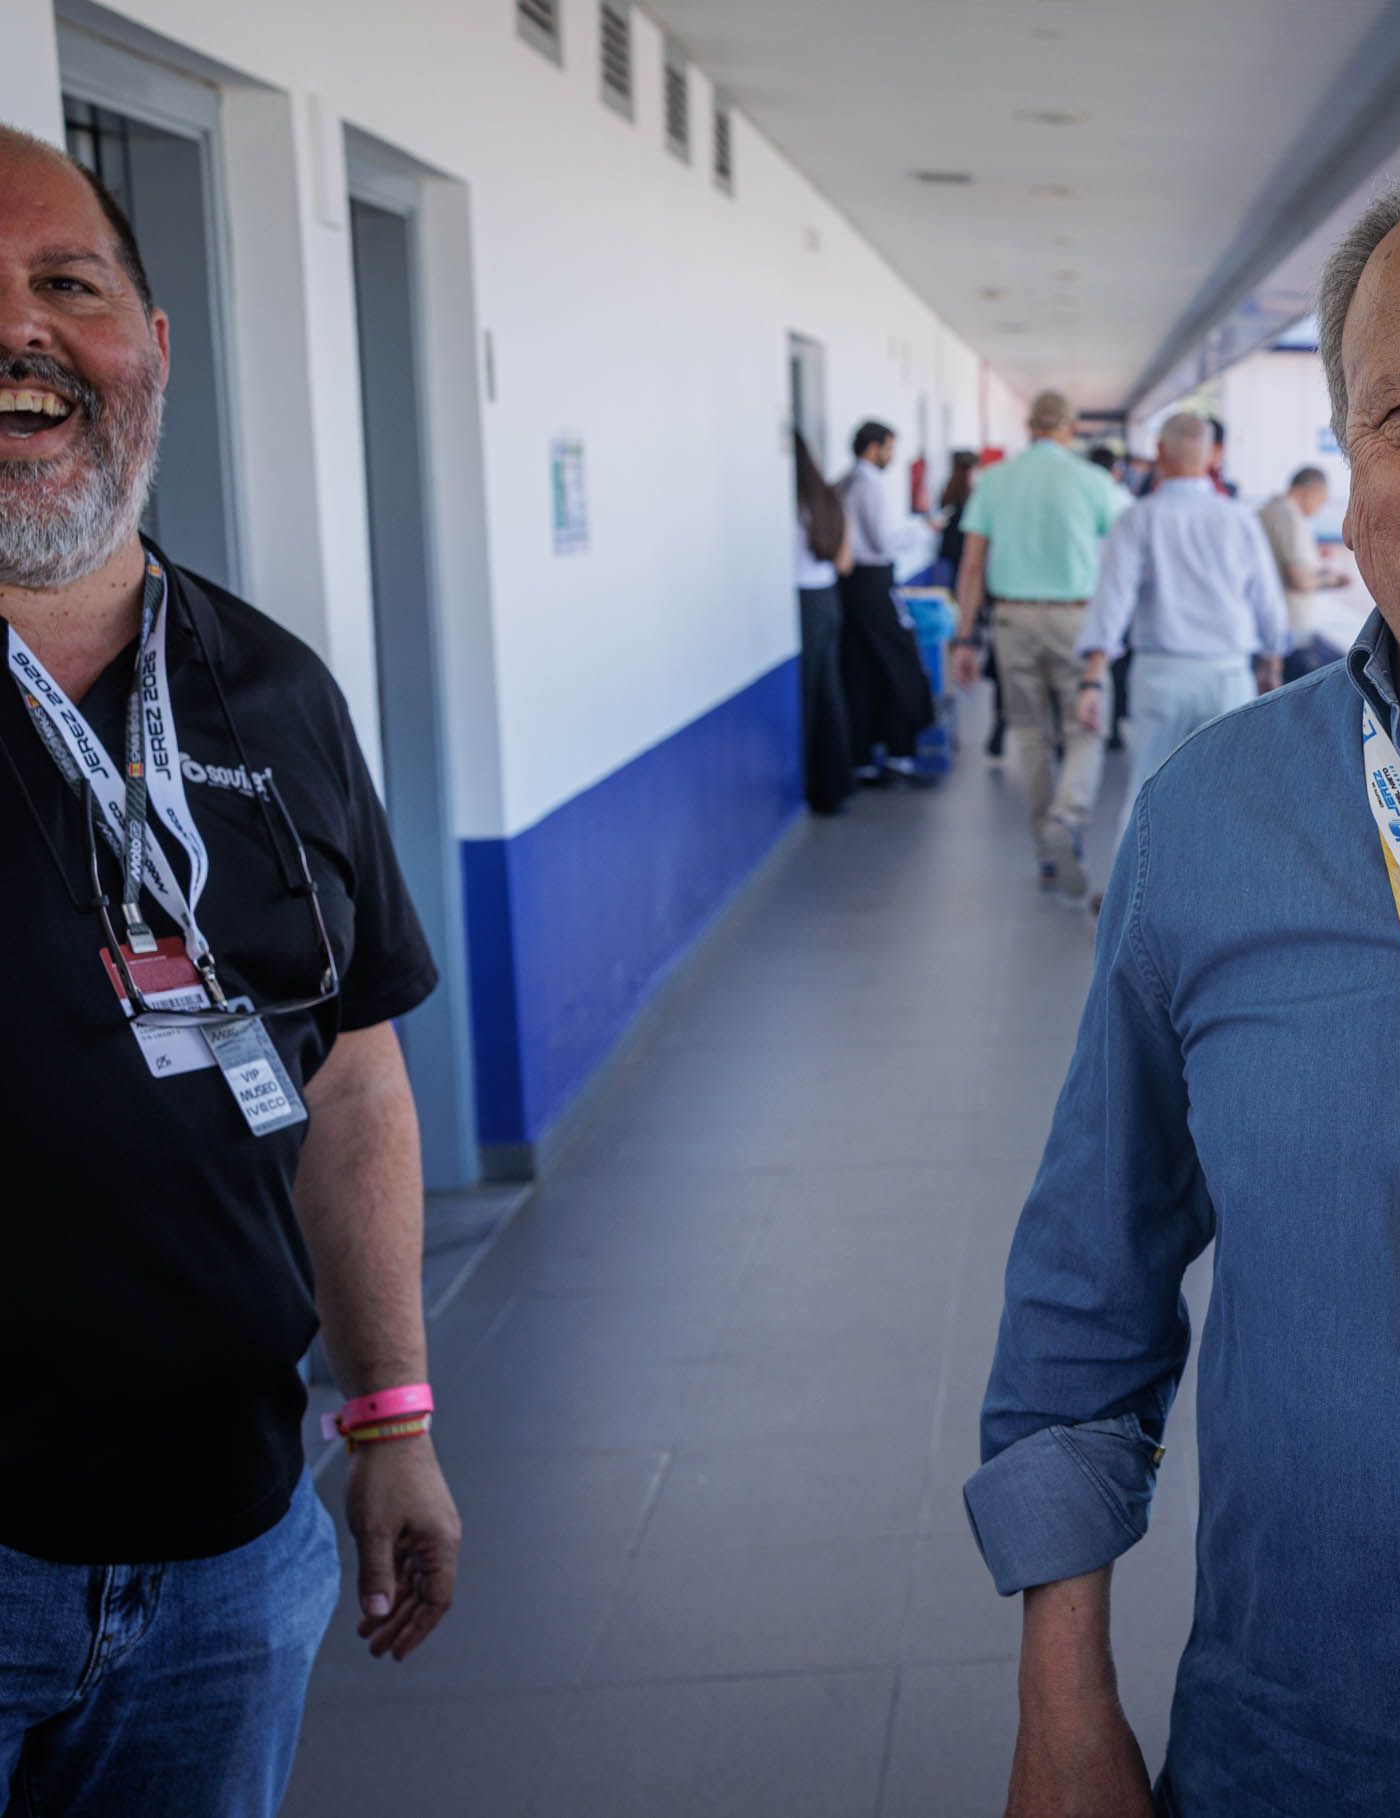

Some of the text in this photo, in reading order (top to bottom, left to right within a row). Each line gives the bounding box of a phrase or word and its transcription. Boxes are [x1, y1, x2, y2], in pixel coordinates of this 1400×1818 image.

[12, 652, 64, 706] 2026
[143, 650, 159, 702] 2026
[60, 709, 110, 779] JEREZ
[146, 706, 171, 781] JEREZ
[1373, 770, 1400, 817] JEREZ
[1382, 767, 1398, 793] NIETO
[239, 1081, 278, 1102] MUSEO
[240, 1068, 259, 1082] VIP
[246, 1096, 286, 1118] IVECO
